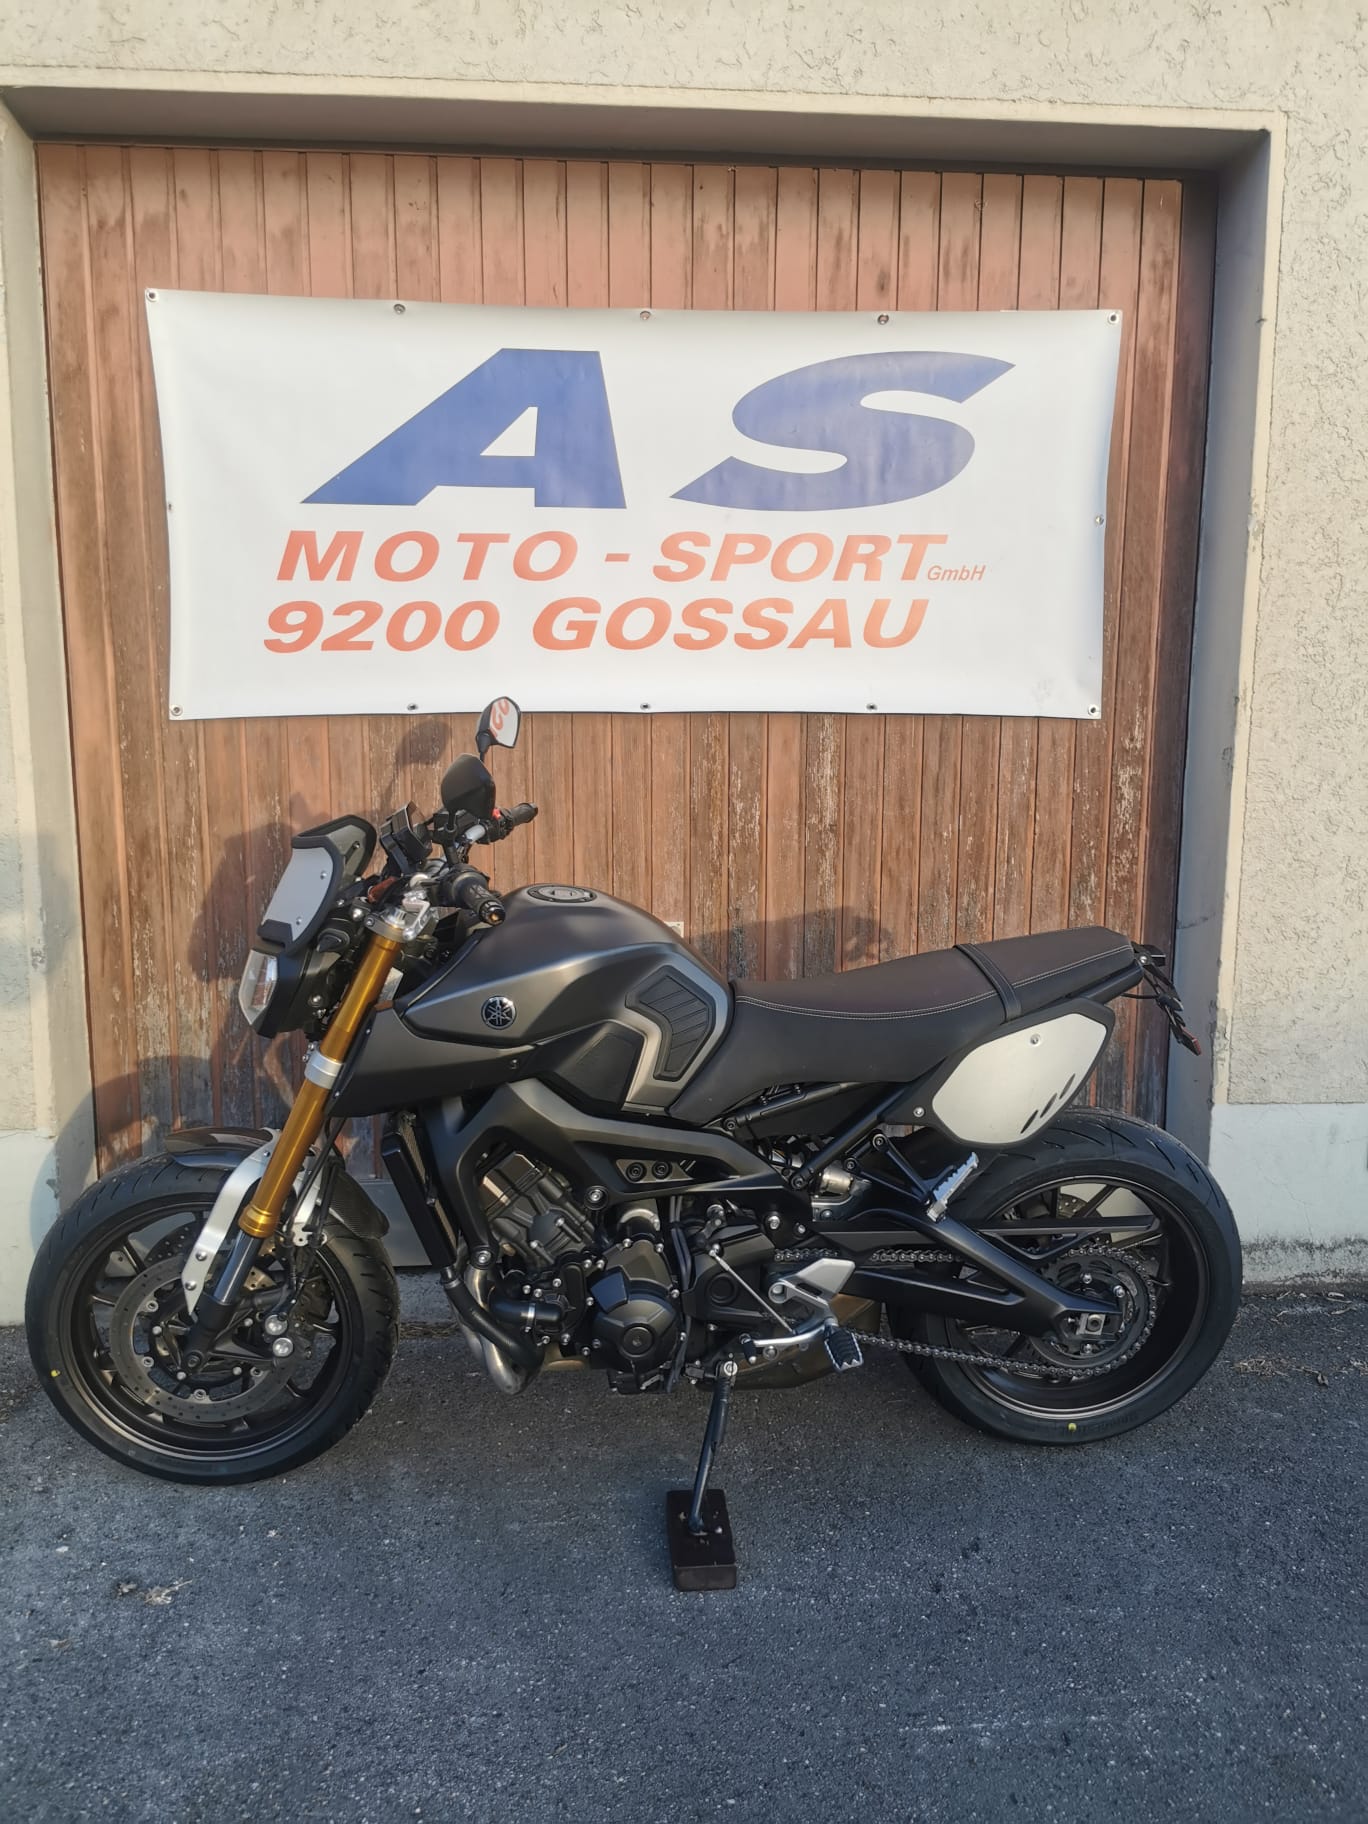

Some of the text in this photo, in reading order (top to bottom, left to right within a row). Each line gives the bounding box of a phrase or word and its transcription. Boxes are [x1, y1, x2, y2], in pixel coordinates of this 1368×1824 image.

[276, 529, 578, 582] MOTO
[652, 531, 948, 583] SPORT
[927, 564, 986, 581] GmbH
[263, 596, 929, 654] 9200 GOSSAU
